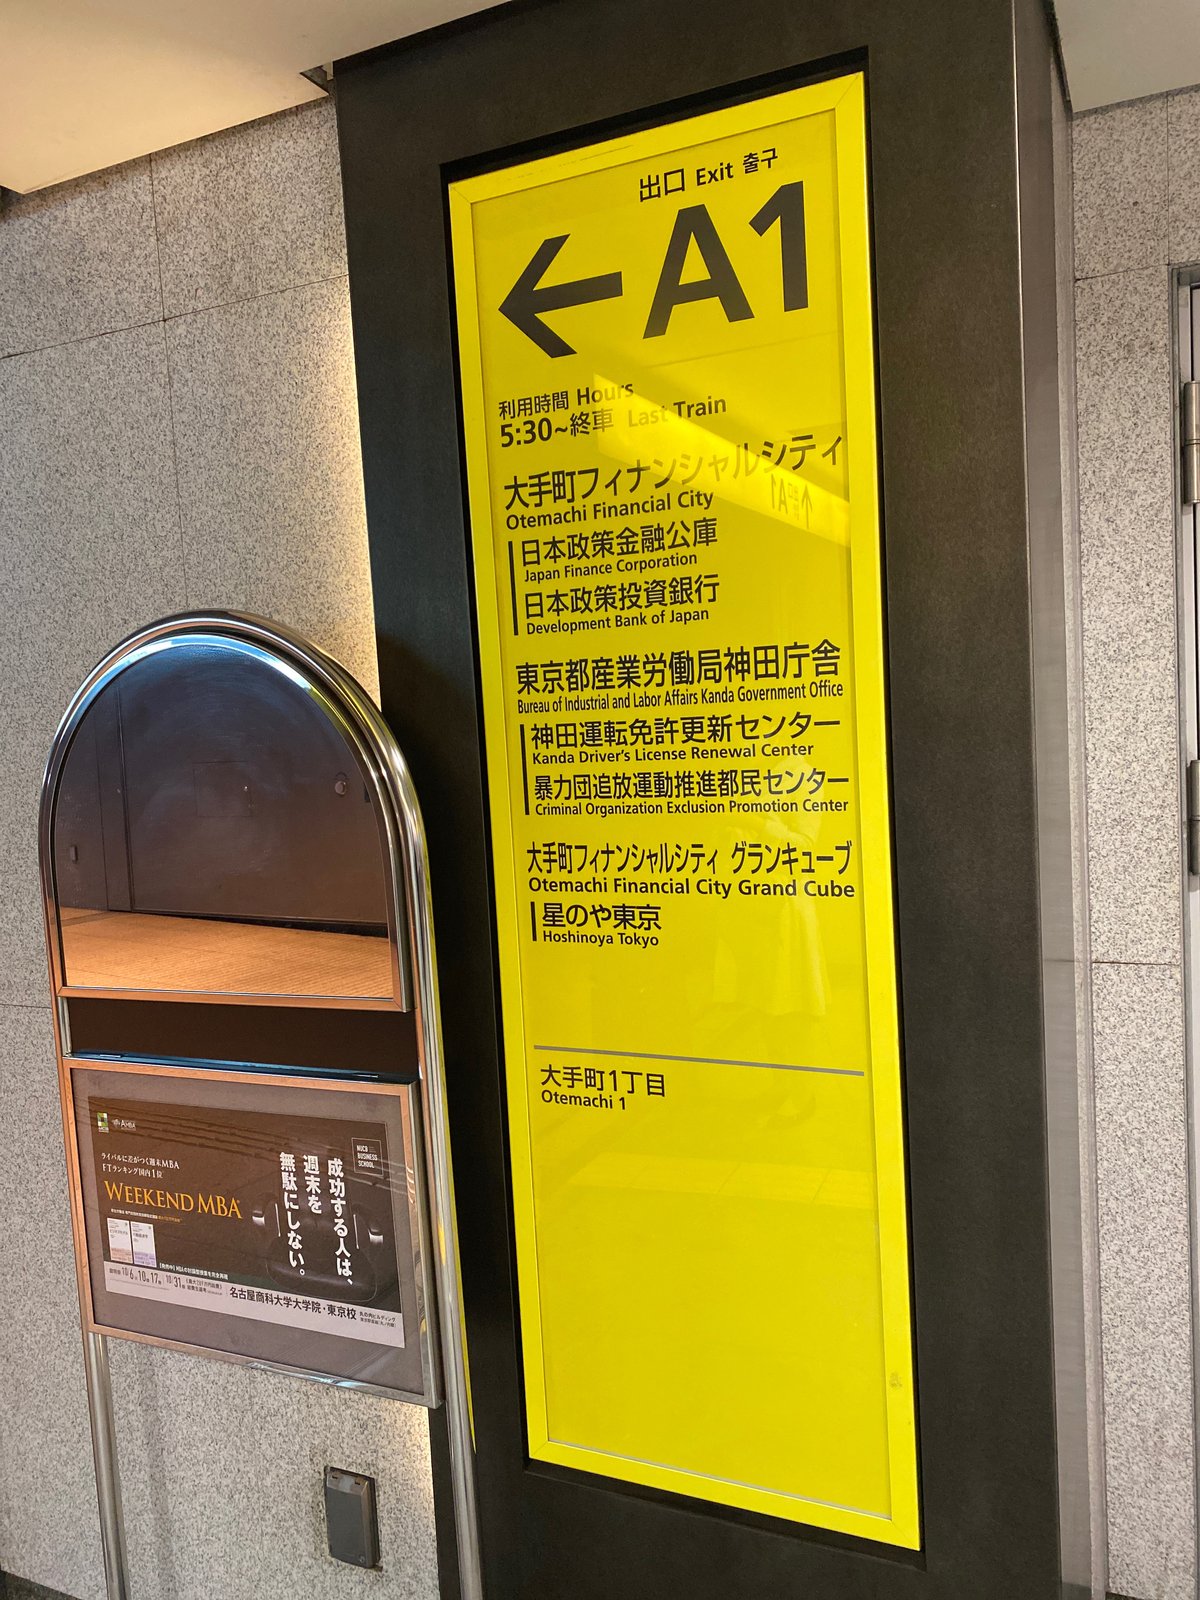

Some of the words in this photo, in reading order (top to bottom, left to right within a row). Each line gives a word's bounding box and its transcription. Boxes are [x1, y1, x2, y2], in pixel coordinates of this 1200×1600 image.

[640, 168, 685, 202] 出口
[696, 162, 734, 186] Exit
[743, 148, 778, 174] 출구
[643, 180, 809, 339] A1
[499, 390, 569, 420] 利用時間
[577, 383, 634, 406] Hours
[628, 406, 668, 428] Last
[674, 396, 727, 420] Train
[503, 433, 844, 511] 大手町フィナンシャルシティ
[506, 506, 587, 530] Otemachi
[593, 497, 672, 520] Financial
[677, 489, 714, 510] City
[522, 517, 719, 567] 日本政策金融公庫
[524, 566, 561, 583] Japan
[564, 561, 612, 579] Finance
[616, 552, 698, 575] Corporation
[525, 573, 720, 619] 日本政策投資銀行
[526, 616, 611, 636] Development
[616, 612, 647, 628] Bank
[651, 611, 666, 625] of
[670, 608, 710, 626] Japan
[516, 638, 841, 695] 東京都産業労働局神田庁舎
[517, 699, 550, 714] Bureau
[552, 697, 563, 712] of
[565, 694, 609, 711] Industrial
[612, 692, 630, 709] and
[633, 691, 661, 708] Labor
[664, 688, 698, 706] Affairs
[701, 687, 734, 704] Kanda
[737, 681, 806, 702] Government
[809, 681, 844, 697] Office
[530, 711, 841, 750] 神田運転免許更新センター
[533, 751, 575, 765] Kanda
[579, 749, 630, 763] Driver's
[635, 747, 687, 760] License
[691, 745, 756, 759] Renewal
[761, 742, 814, 757] Center
[534, 767, 849, 802] 暴力団追放運動推進都民センター
[535, 802, 582, 816] Criminal
[585, 800, 663, 818] Organization
[668, 799, 725, 814] Exclusion
[729, 799, 798, 813] Promotion
[803, 799, 849, 812] Center
[527, 841, 718, 875] 大手町フィナンシャルシティ
[732, 840, 853, 875] グランキューブ
[528, 877, 608, 894] Otemachi
[613, 877, 690, 895] Financial
[696, 879, 732, 899] City
[738, 879, 797, 896] Grand
[804, 881, 855, 897] Cube
[542, 903, 662, 931] 星のや東京
[543, 931, 614, 947] Hoshinoya
[617, 932, 659, 948] Tokyo
[540, 1064, 666, 1097] 大手町1丁目
[541, 1089, 613, 1110] Otemachi
[619, 1097, 626, 1110] 1
[358, 1160, 374, 1168] SCHOOL
[104, 1180, 194, 1212] WEEKEND
[304, 1155, 322, 1214] 週末を
[280, 1152, 305, 1276] 無駄にしない。
[328, 1158, 353, 1285] 成功する人は、
[230, 1287, 357, 1320] 名古屋商科大学大学院・東京校
